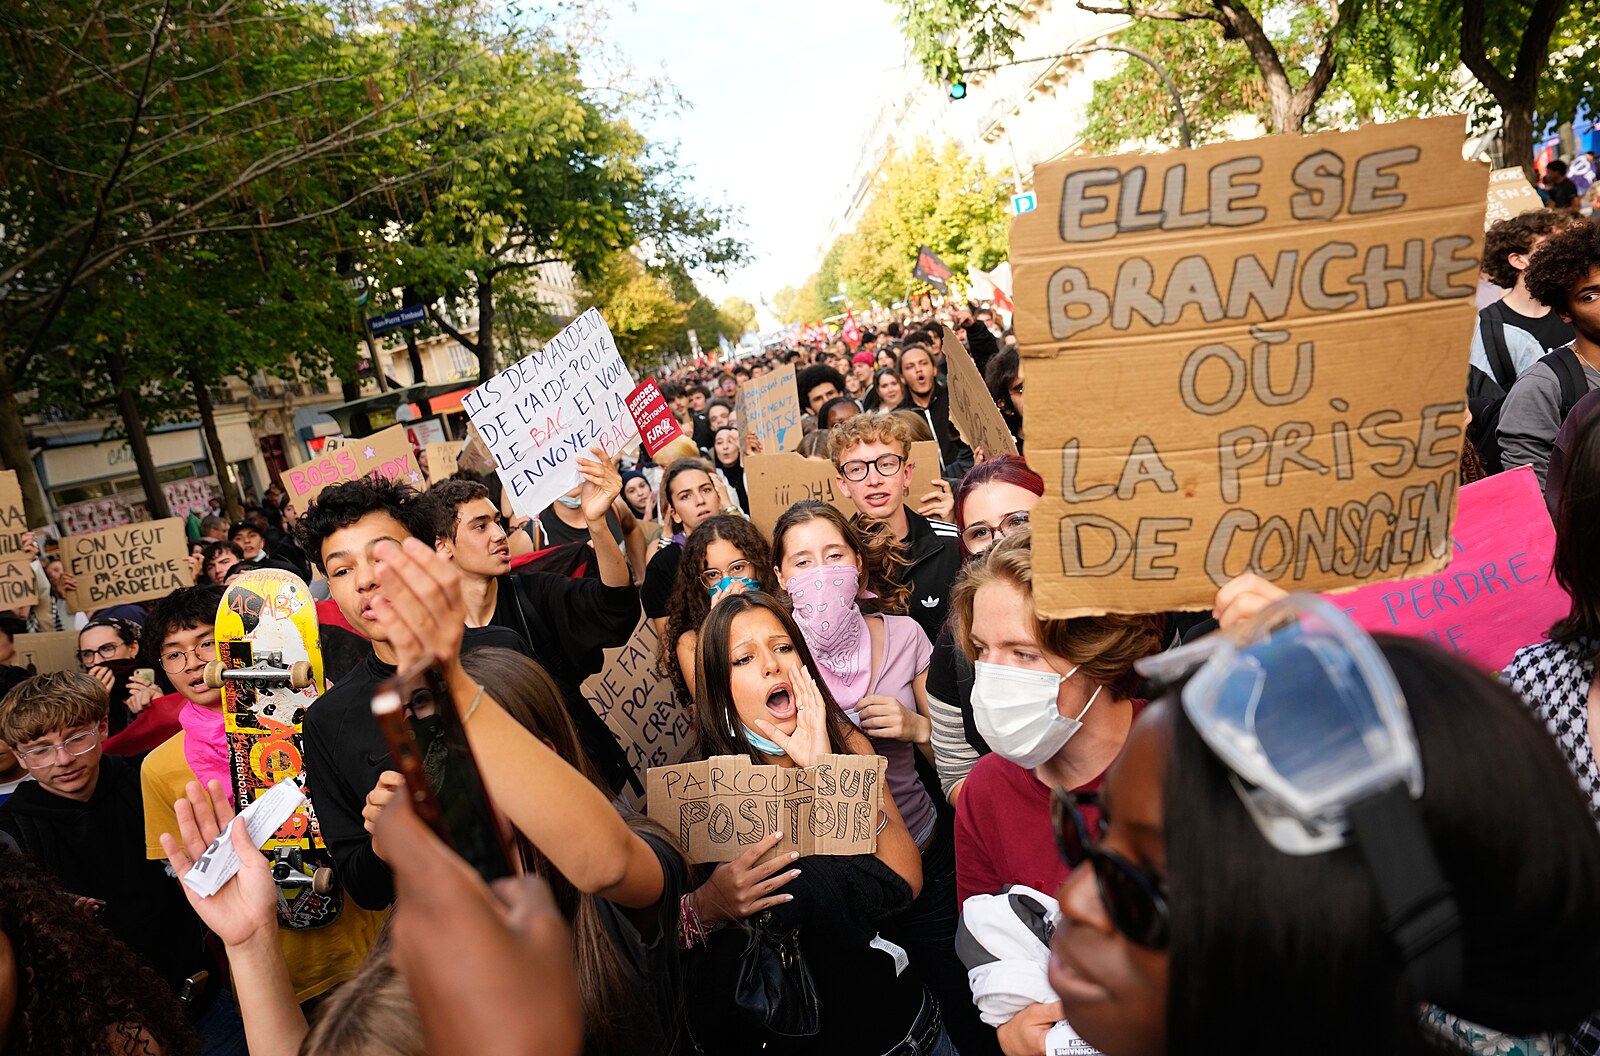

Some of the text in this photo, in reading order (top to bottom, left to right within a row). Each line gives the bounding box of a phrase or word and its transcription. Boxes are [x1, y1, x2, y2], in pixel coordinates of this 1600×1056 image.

[1060, 146, 1422, 242] ELLE SE
[1047, 234, 1480, 340] BRANCHE
[462, 380, 502, 418] ILS
[479, 411, 516, 448] DE
[568, 336, 610, 378] POUR
[629, 383, 655, 412] DEHORS
[633, 389, 660, 418] MACRON
[496, 442, 527, 471] LE
[529, 406, 573, 448] BAC
[572, 386, 596, 416] ET
[511, 419, 602, 497] ENVOYEZ
[604, 392, 626, 423] LA
[599, 412, 639, 457] BAC
[1061, 398, 1466, 503] LA PRISE
[289, 451, 357, 497] BOSS
[72, 546, 156, 576] ETUDIER
[76, 527, 165, 555] ON VEUT
[1059, 513, 1193, 581] DE
[89, 573, 185, 602] BARDELLA
[94, 559, 179, 585] PAS COMME
[1381, 551, 1539, 626] PERDRE
[227, 594, 295, 621] ACAB
[587, 668, 625, 722] QUE
[680, 796, 872, 853] POSITOIR
